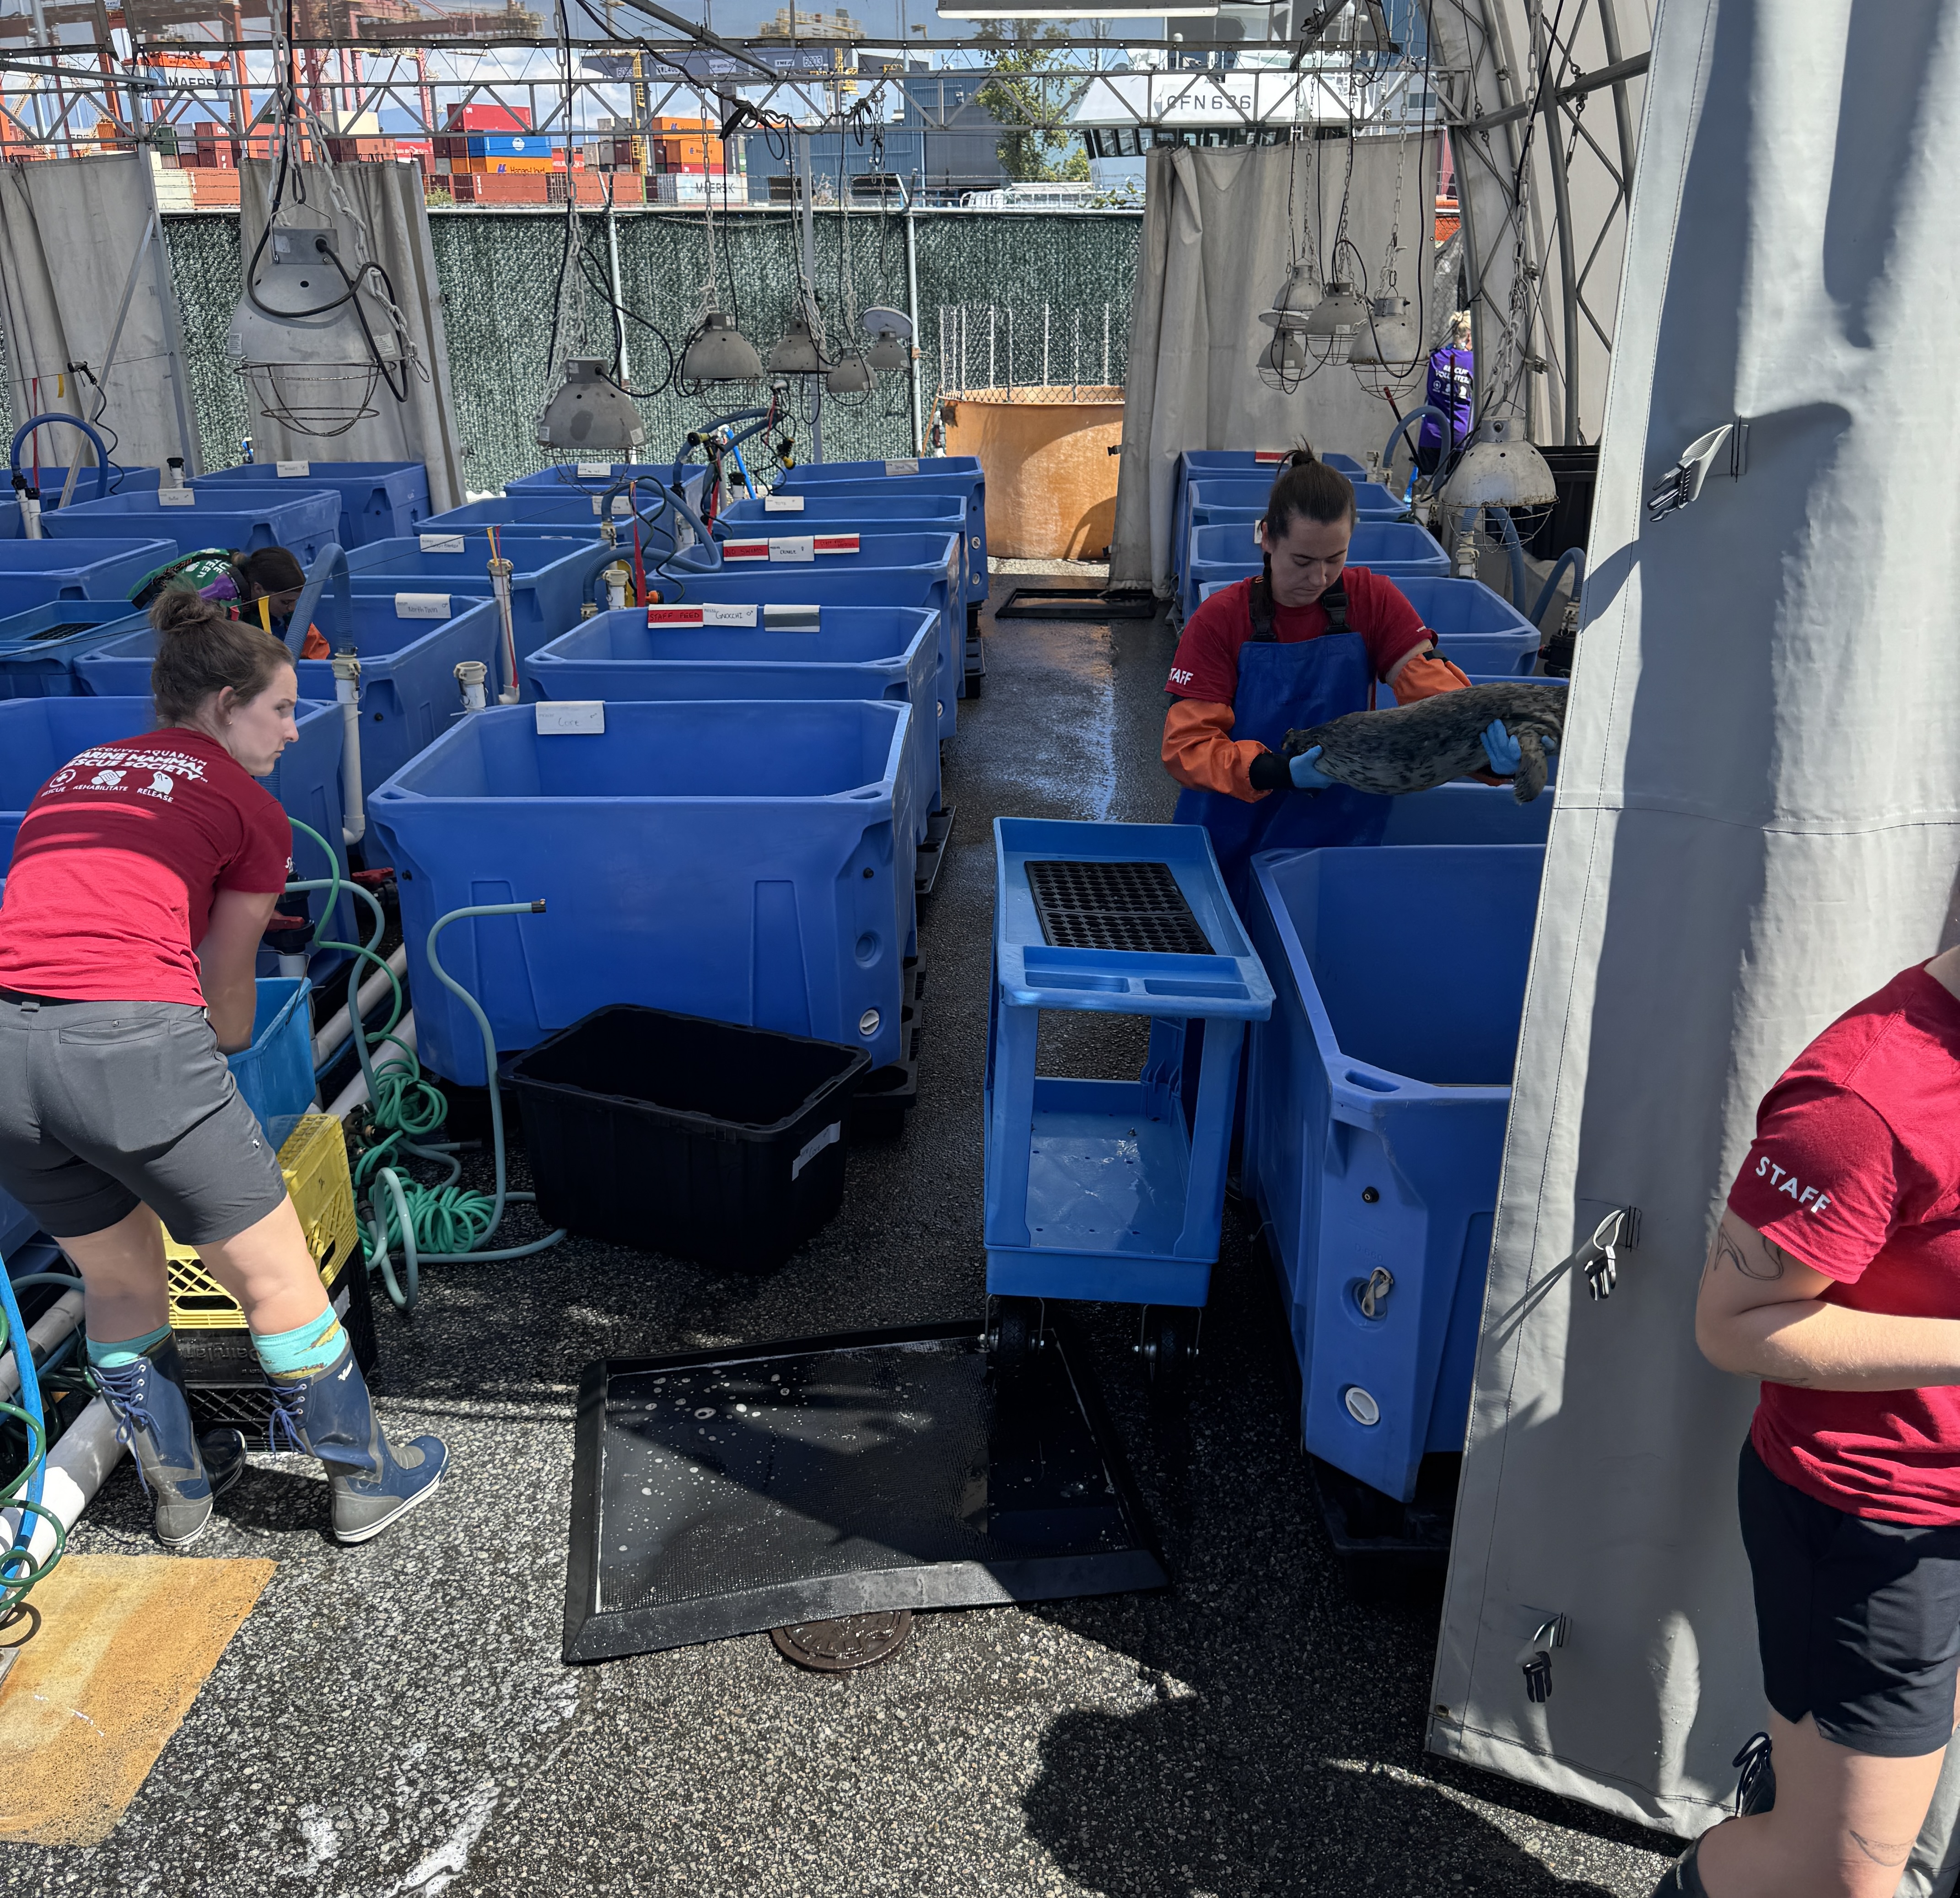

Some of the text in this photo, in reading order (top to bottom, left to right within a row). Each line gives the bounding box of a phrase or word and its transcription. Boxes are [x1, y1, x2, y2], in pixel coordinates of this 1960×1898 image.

[650, 613, 673, 621] STAFF
[1168, 668, 1194, 685] TAFF
[126, 753, 204, 775] MAMMAL
[144, 750, 207, 766] AQUARIUM
[137, 788, 173, 803] RELEASE
[1755, 1156, 1831, 1213] STAFF
